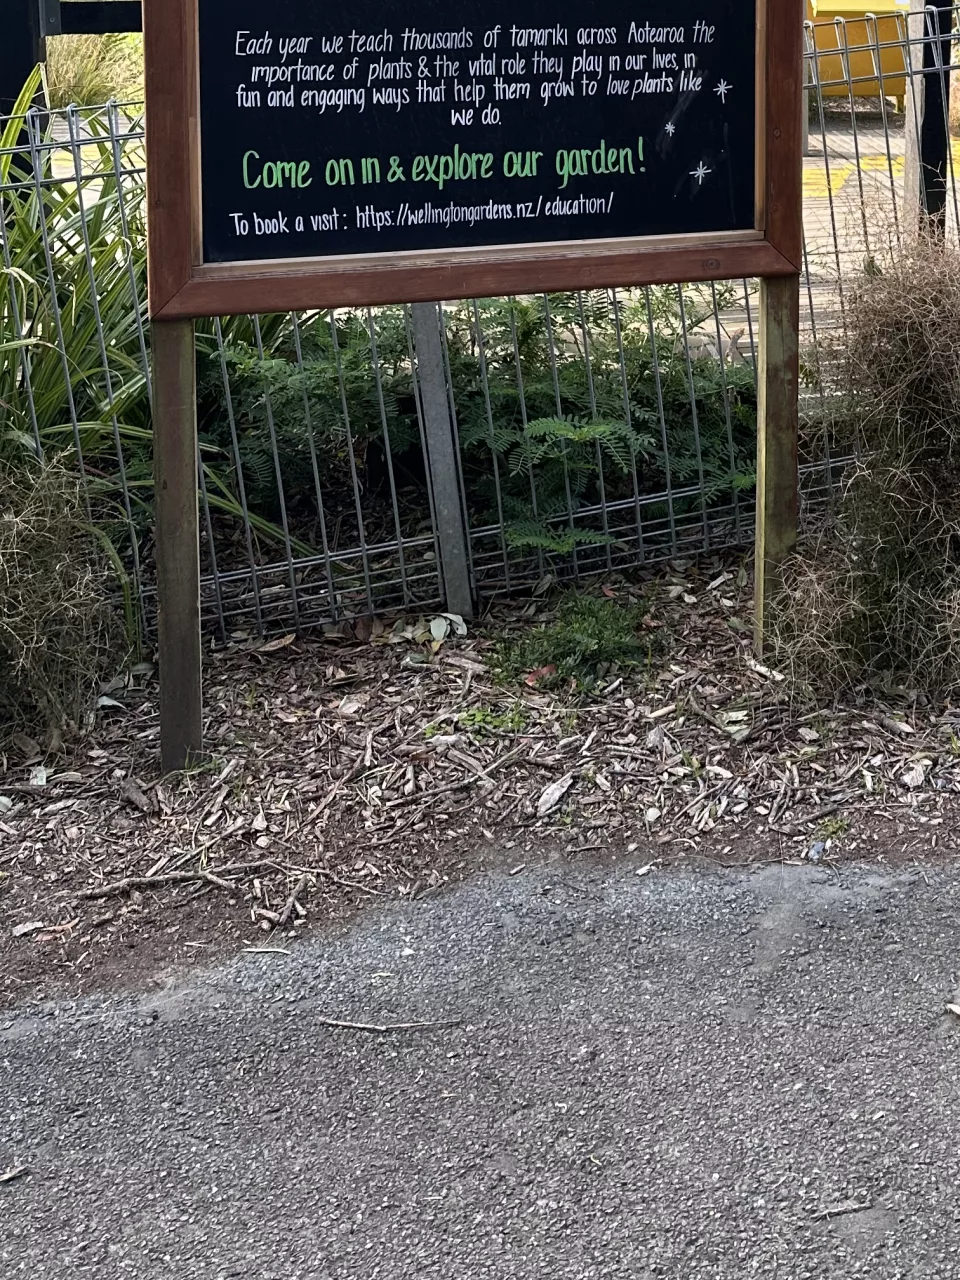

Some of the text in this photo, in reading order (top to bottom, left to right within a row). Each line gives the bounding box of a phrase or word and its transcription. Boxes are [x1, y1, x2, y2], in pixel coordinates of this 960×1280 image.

[235, 19, 716, 64] Each year we teach thousands of tamariki across Aotearoa the
[251, 46, 696, 88] importance of plants & the vital role they play in our lives, in
[235, 69, 703, 115] fun and engaging ways that help them grow to love plants like
[450, 102, 503, 127] we do.
[242, 136, 646, 191] Come on in & explore our garden!
[228, 212, 249, 236] To
[252, 210, 290, 236] book
[294, 215, 305, 232] a
